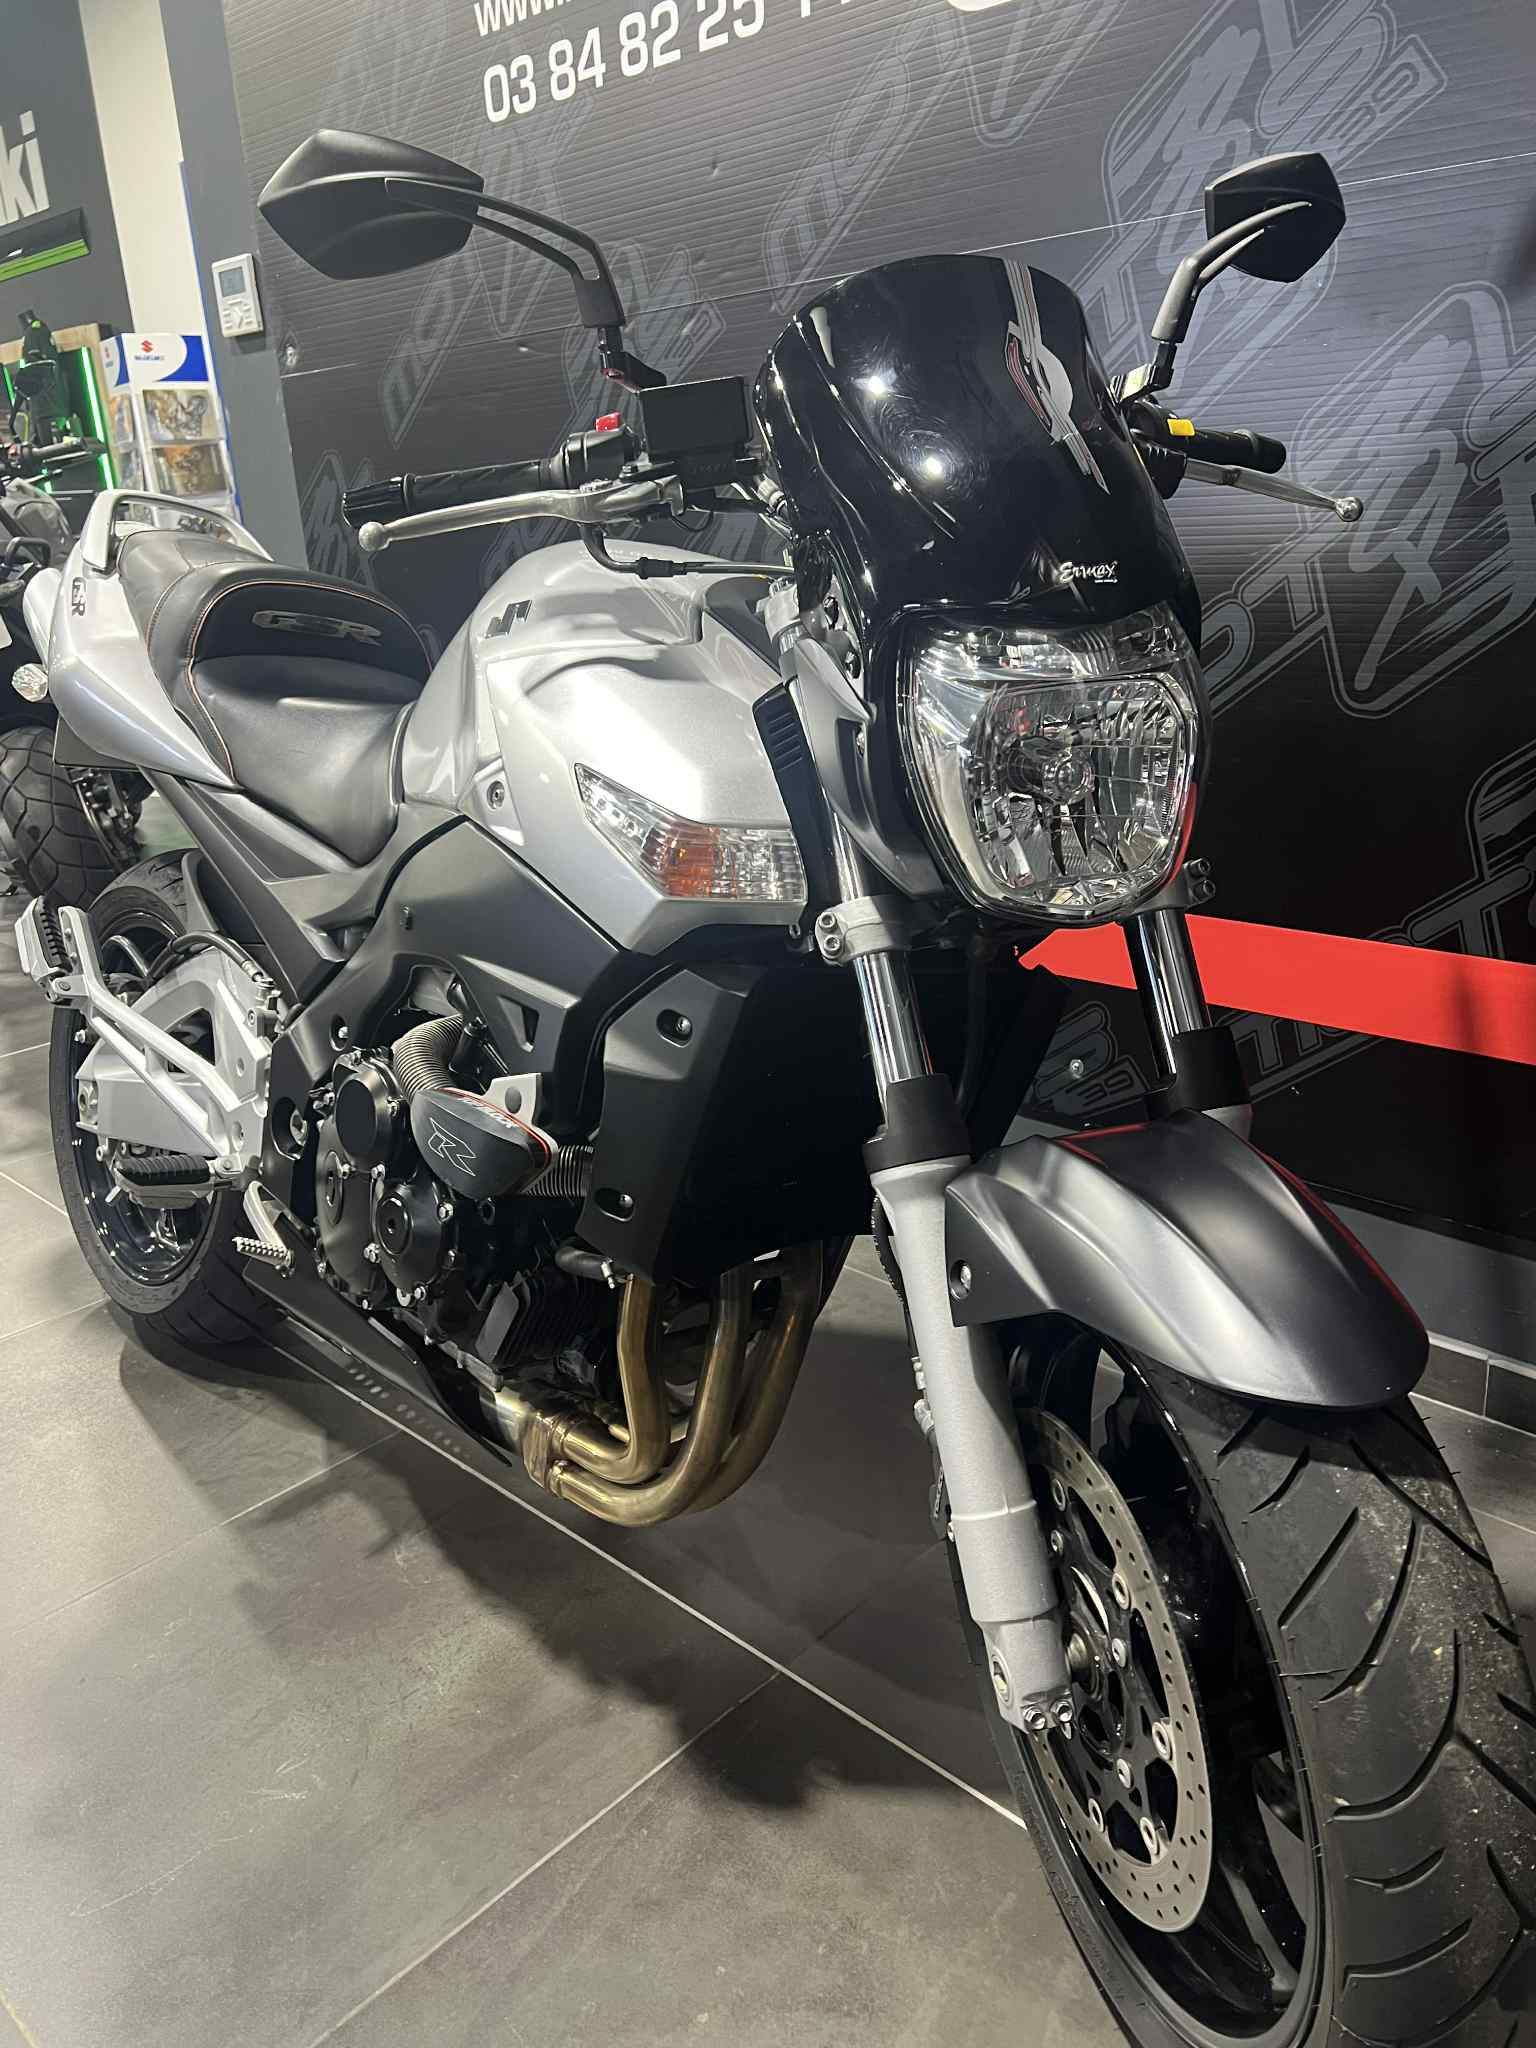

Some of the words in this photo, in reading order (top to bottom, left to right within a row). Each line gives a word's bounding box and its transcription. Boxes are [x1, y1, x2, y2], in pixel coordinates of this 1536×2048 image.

[484, 54, 536, 123] 03
[549, 27, 606, 101] 84
[618, 0, 681, 77] 82
[251, 608, 382, 647] GSR
